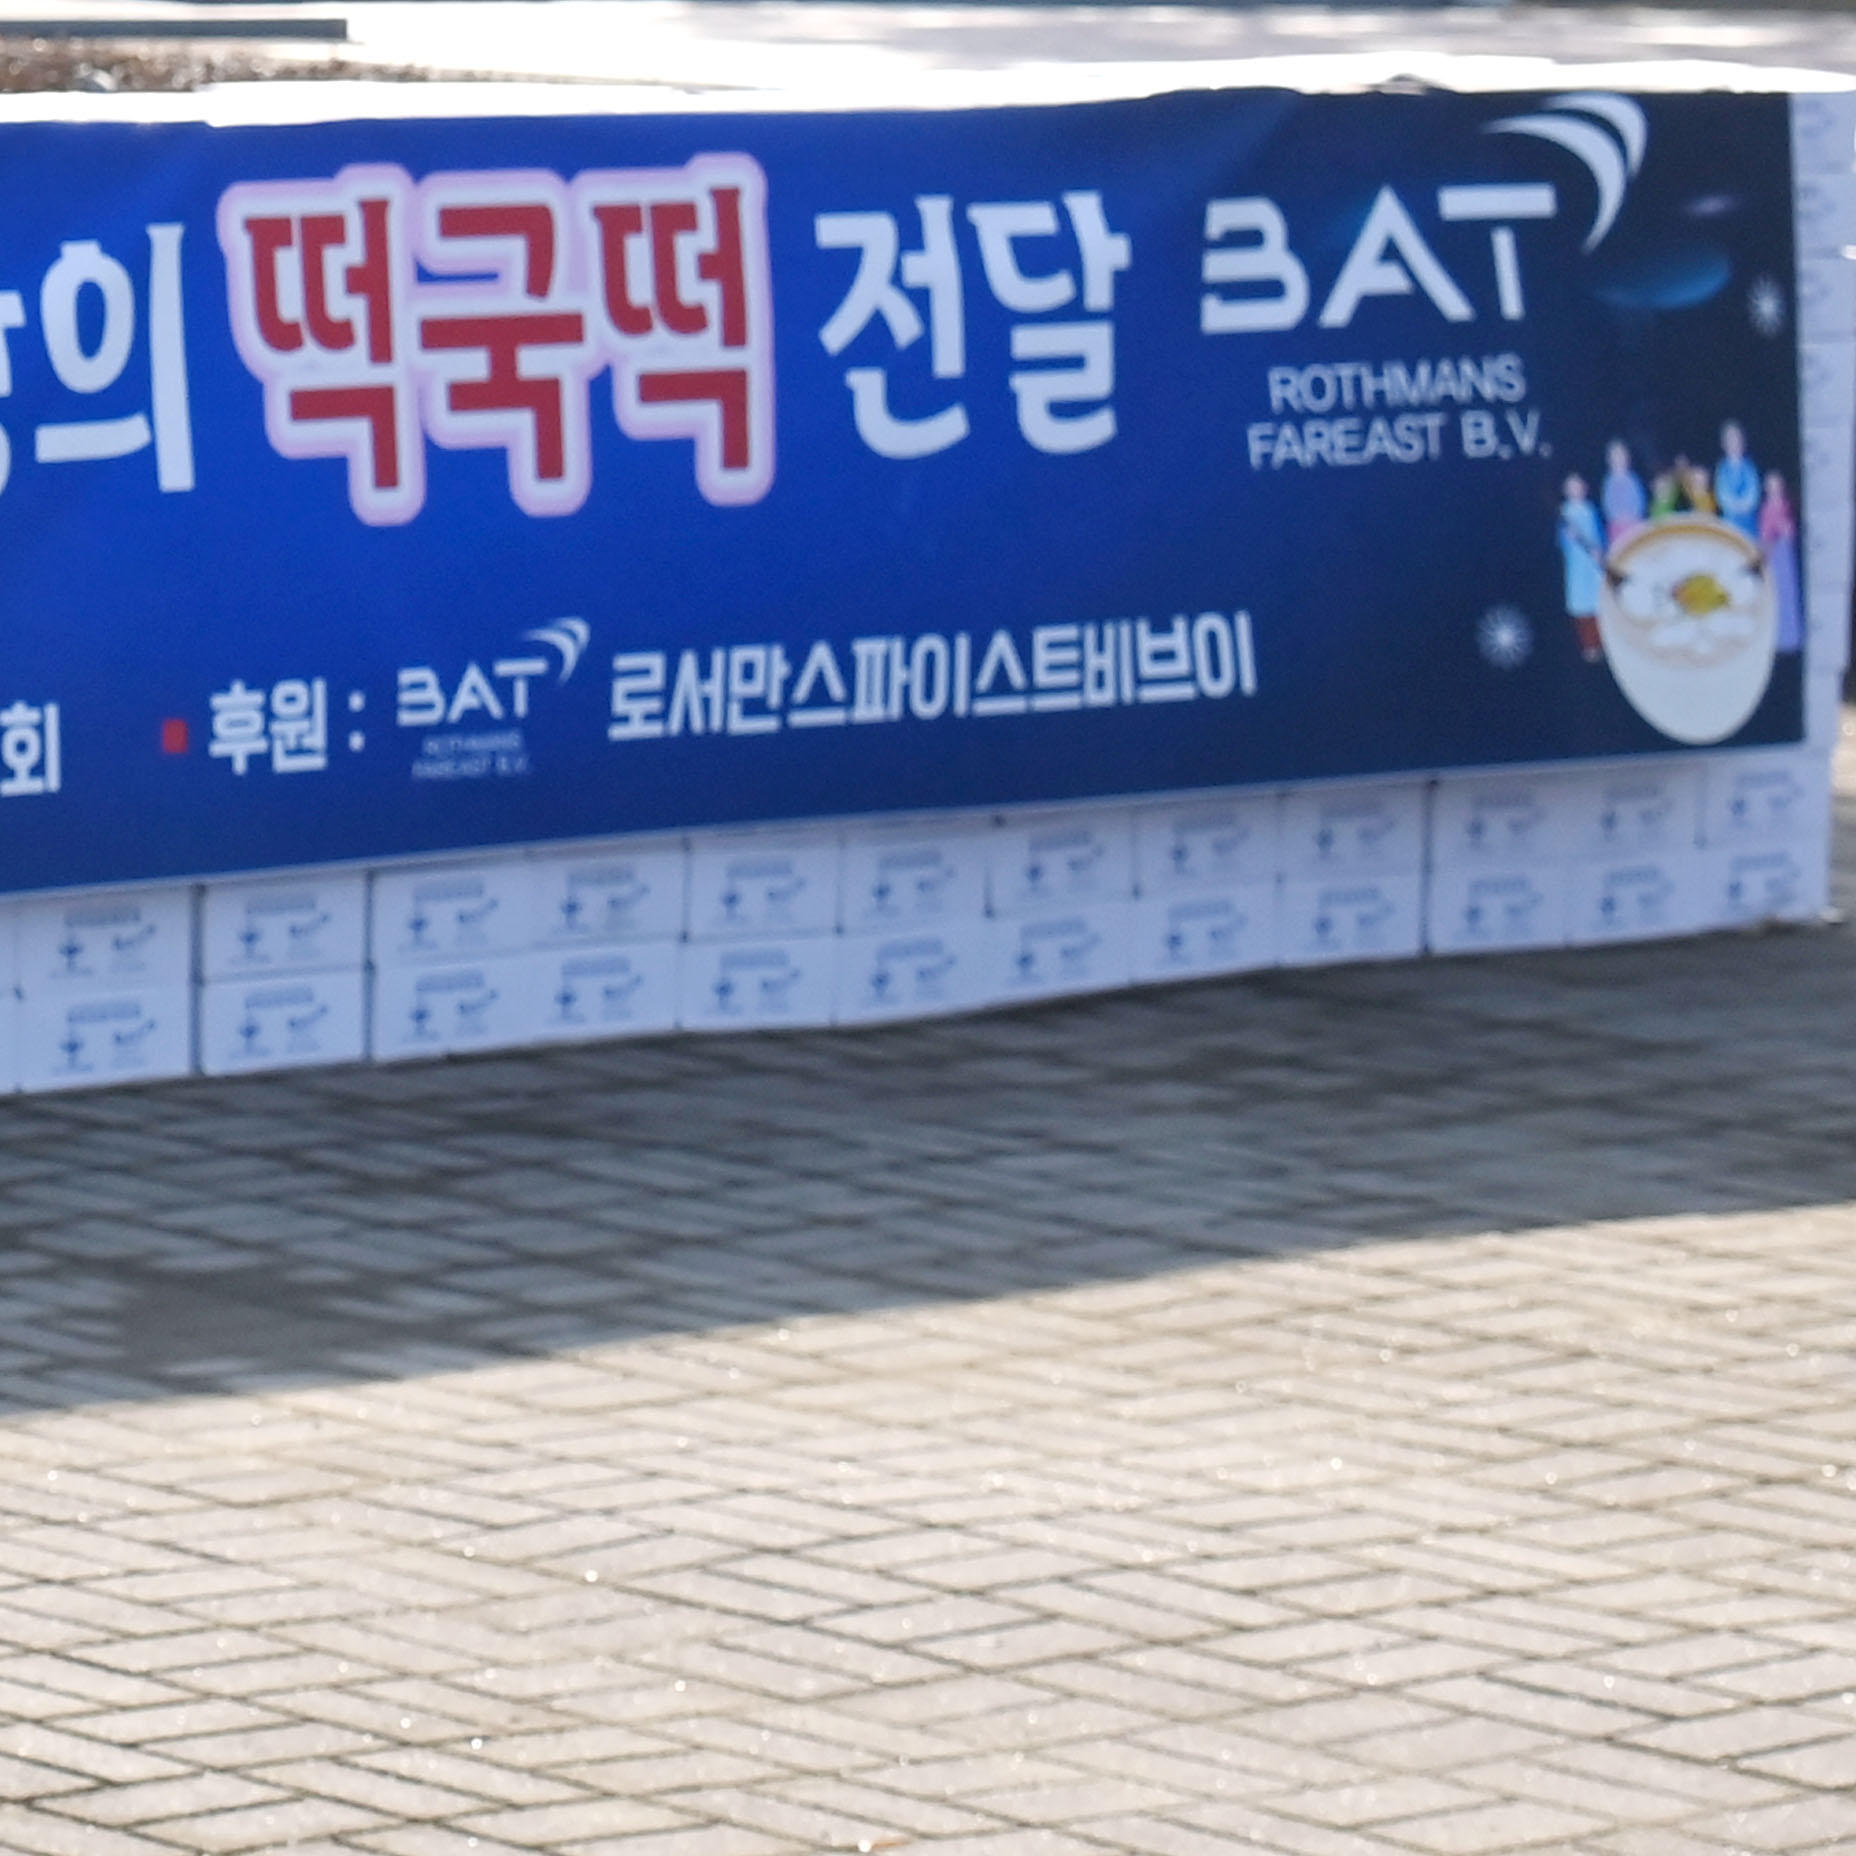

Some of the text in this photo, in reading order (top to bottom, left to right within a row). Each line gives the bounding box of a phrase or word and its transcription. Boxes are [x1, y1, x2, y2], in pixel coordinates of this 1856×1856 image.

[1200, 183, 1557, 334] BAT
[238, 178, 758, 498] 떡국떡
[815, 193, 1130, 457] 전달
[1267, 353, 1527, 414] ROTHMANS
[1246, 406, 1551, 470] FAREAST B.V.
[208, 678, 328, 776] 후원
[396, 658, 549, 727] BAT
[607, 610, 1256, 742] 로서만스파이스트비브이
